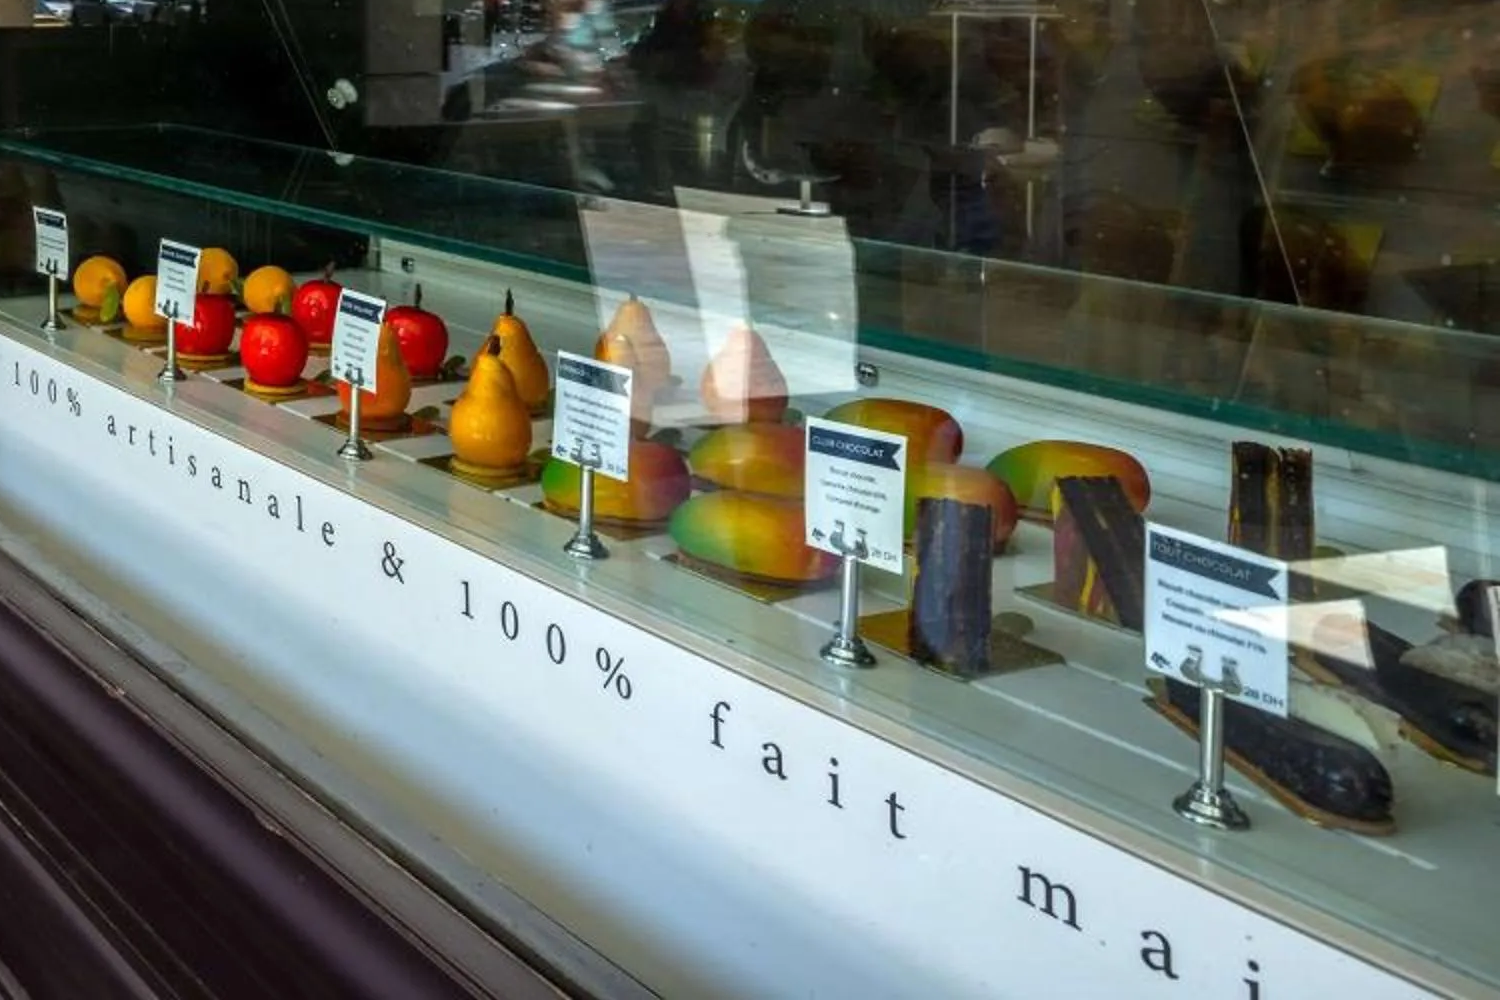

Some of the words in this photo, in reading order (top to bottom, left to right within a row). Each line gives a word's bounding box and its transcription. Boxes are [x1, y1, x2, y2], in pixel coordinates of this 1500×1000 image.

[835, 439, 884, 458] CHOCOLAT
[13, 361, 82, 418] 100%
[106, 411, 336, 547] artisanale
[380, 540, 405, 585] &
[459, 580, 633, 700] 100%
[709, 700, 908, 840] fait
